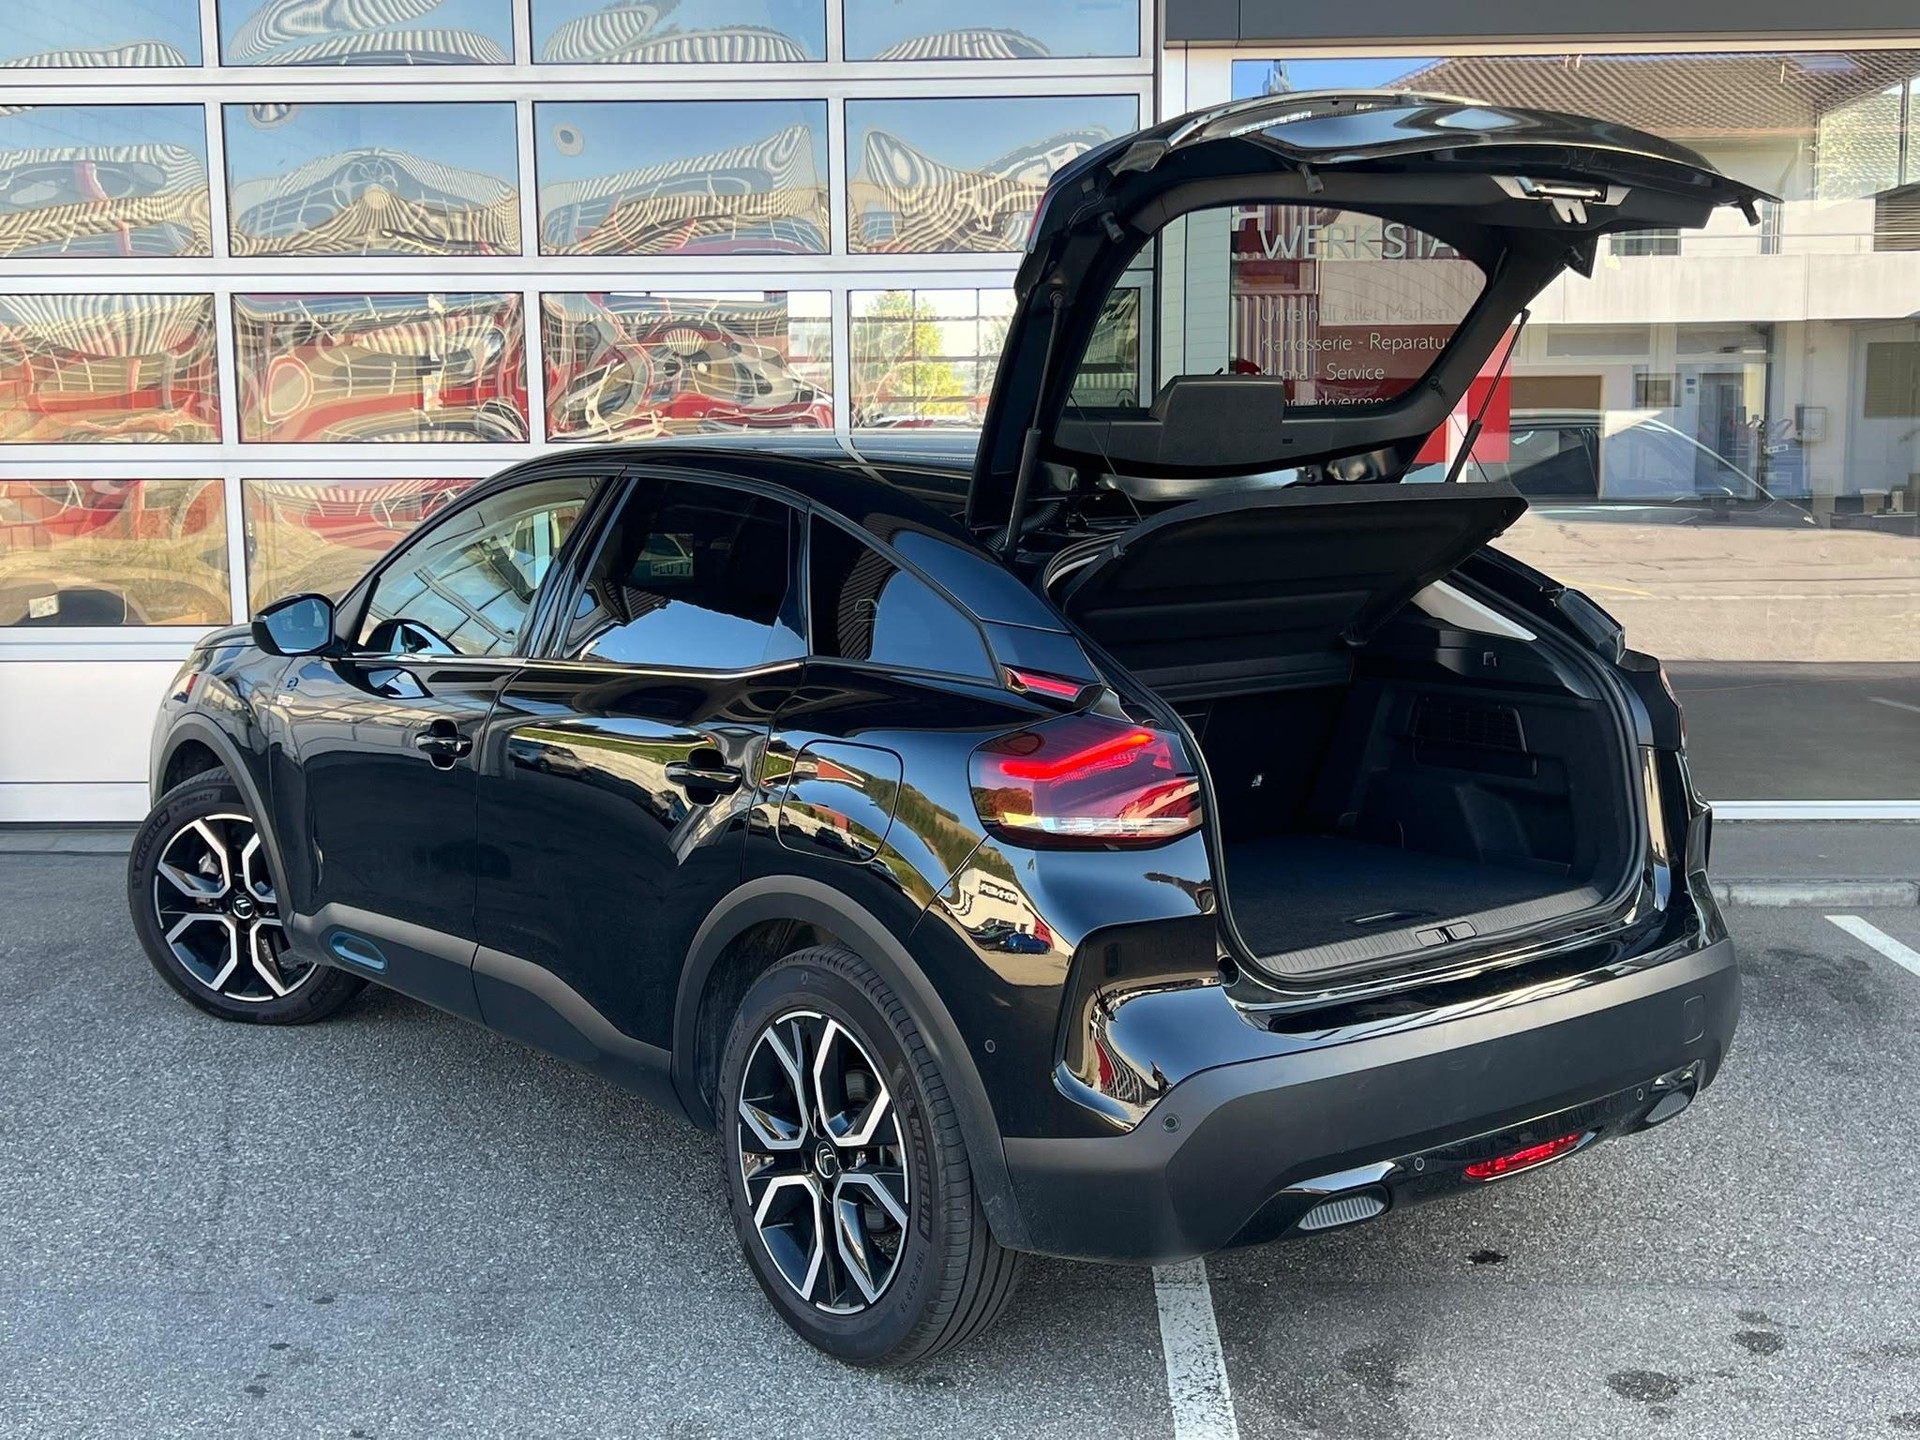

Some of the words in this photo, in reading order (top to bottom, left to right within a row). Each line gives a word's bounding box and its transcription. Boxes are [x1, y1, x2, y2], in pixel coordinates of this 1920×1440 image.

[1369, 333, 1450, 354] Reparatu
[1326, 363, 1385, 380] Service
[909, 1117, 931, 1237] MICHELIN
